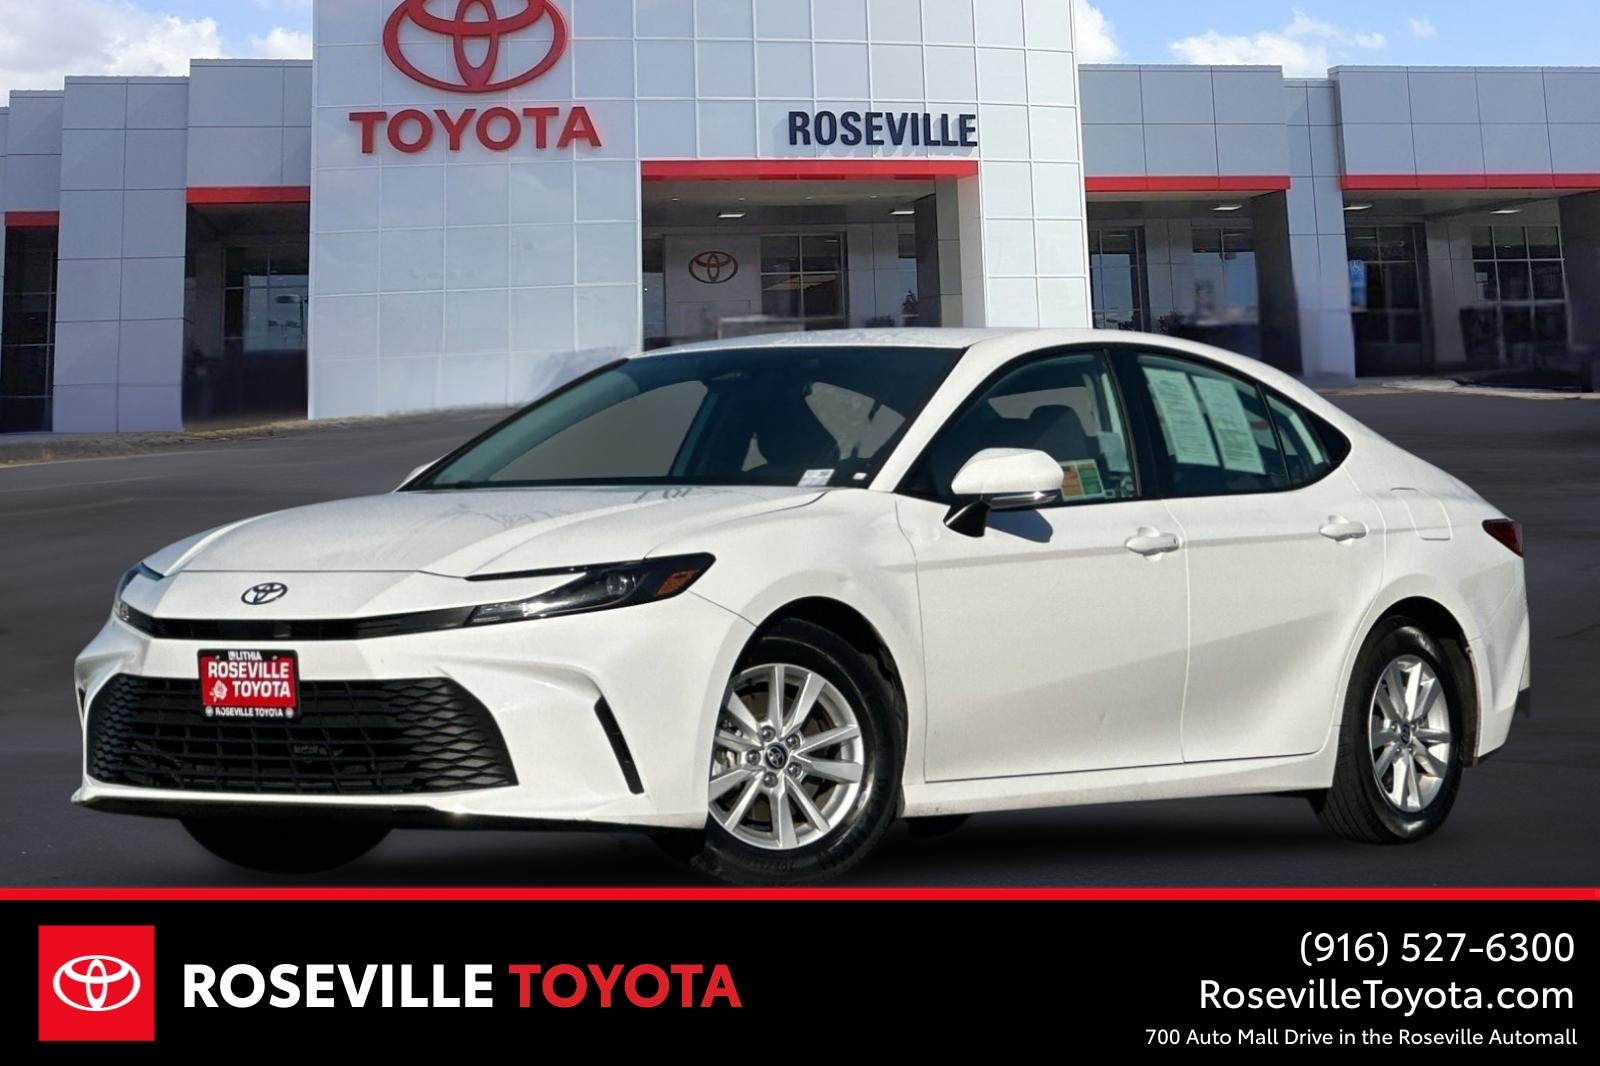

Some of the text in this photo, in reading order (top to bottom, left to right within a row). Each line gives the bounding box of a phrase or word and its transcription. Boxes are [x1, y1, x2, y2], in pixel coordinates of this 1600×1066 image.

[349, 106, 602, 154] TOYOTA
[788, 111, 978, 147] ROSEVILLE
[235, 651, 262, 661] LITHIA
[208, 662, 290, 678] ROSEVILLE
[232, 681, 291, 698] TOYOTA
[215, 707, 284, 717] ROSEVILLE TOYOTA
